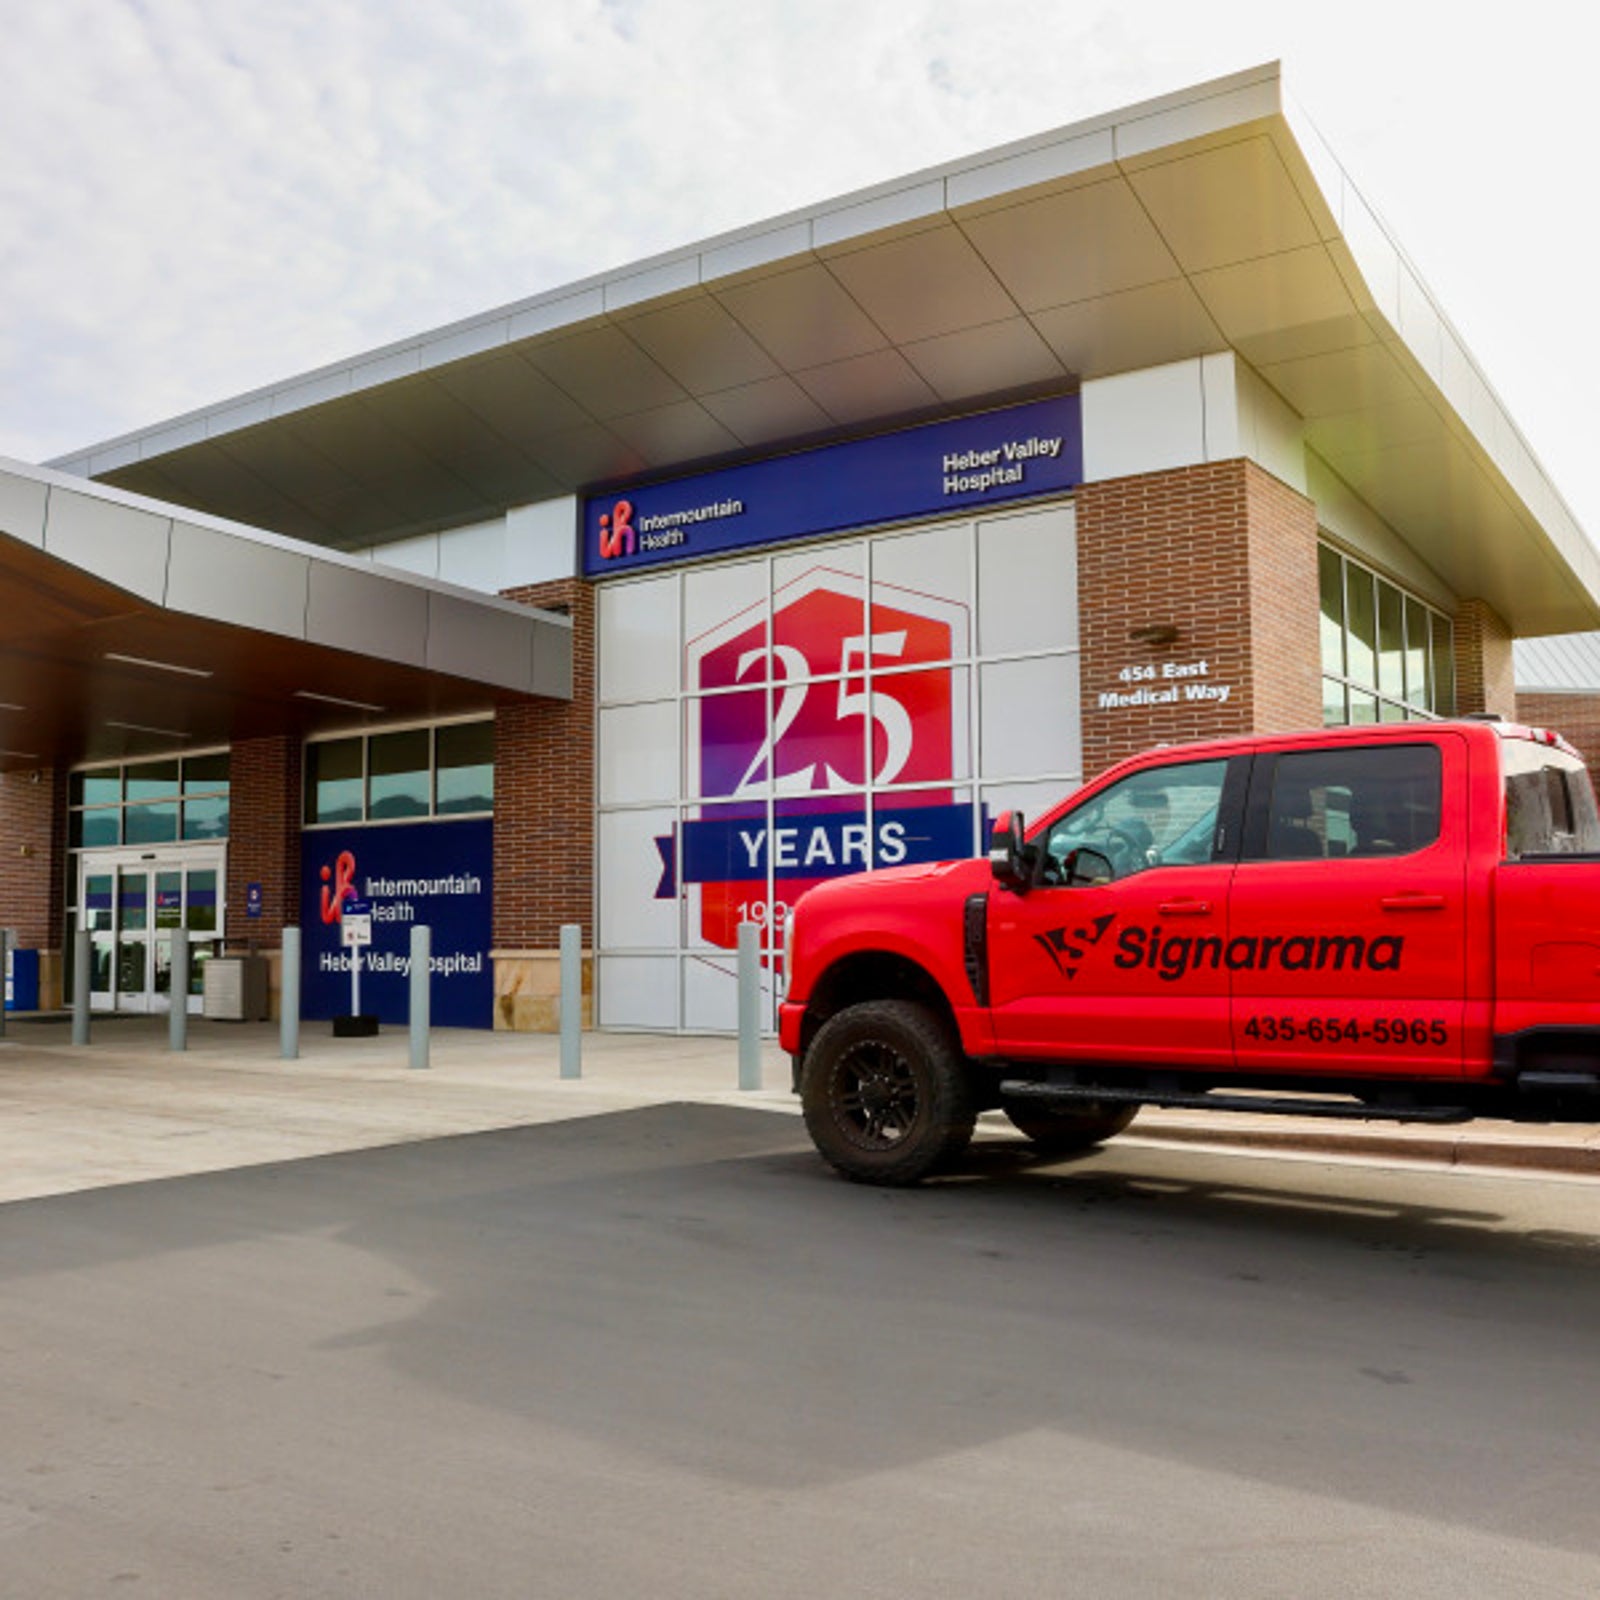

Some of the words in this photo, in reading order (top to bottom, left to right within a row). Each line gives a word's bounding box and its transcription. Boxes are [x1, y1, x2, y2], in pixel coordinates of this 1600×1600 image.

[943, 449, 1000, 473] Heber
[1003, 437, 1062, 461] Valley
[943, 463, 1023, 494] Hospital
[639, 499, 743, 531] Intermountain
[639, 529, 684, 550] Health
[1118, 665, 1155, 681] 454
[1162, 660, 1208, 678] East
[1098, 687, 1178, 707] Medical
[1185, 685, 1230, 702] Way
[732, 630, 913, 797] 25
[739, 821, 907, 868] YEARS
[365, 872, 481, 897] Intermountain
[737, 900, 788, 931] 199
[320, 952, 365, 972] Hebr
[366, 952, 411, 977] Valley
[429, 951, 482, 977] ospital
[1114, 925, 1403, 981] Signarama
[1244, 1016, 1449, 1046] 435-654-5965
